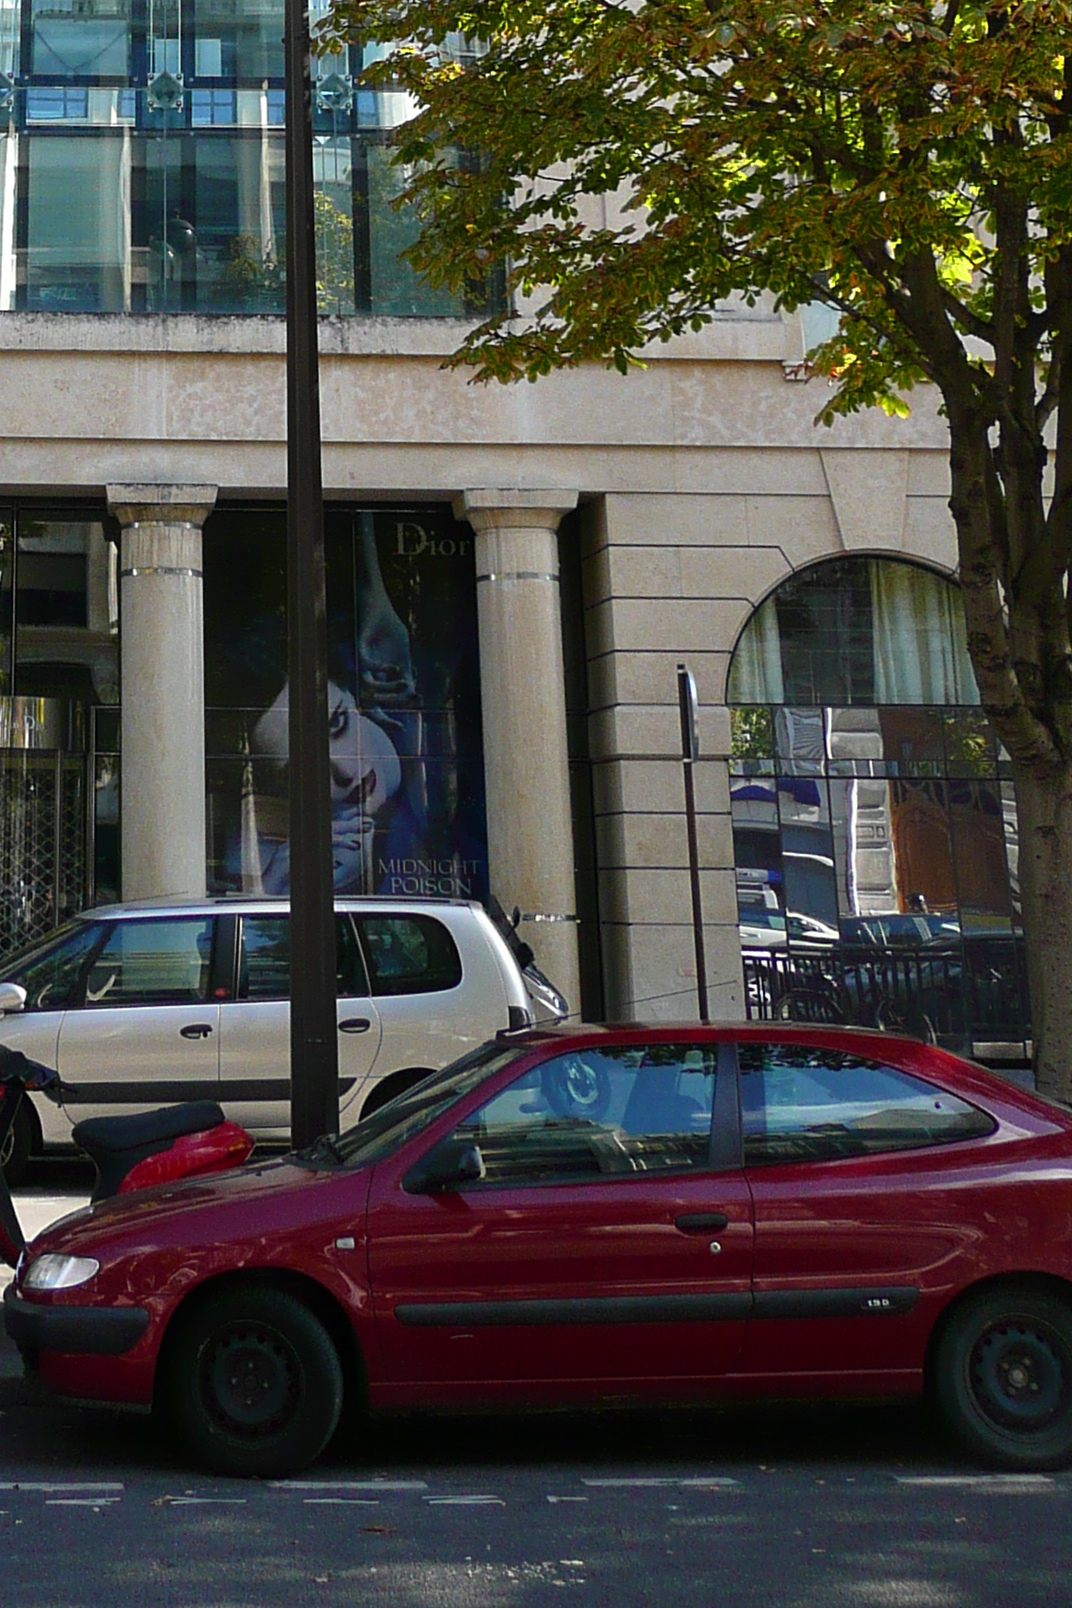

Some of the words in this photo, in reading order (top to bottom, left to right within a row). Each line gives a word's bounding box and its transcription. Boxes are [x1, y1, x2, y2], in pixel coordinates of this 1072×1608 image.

[392, 522, 469, 556] Dior
[378, 858, 481, 875] MIDNIGHT
[391, 876, 471, 895] POISON
